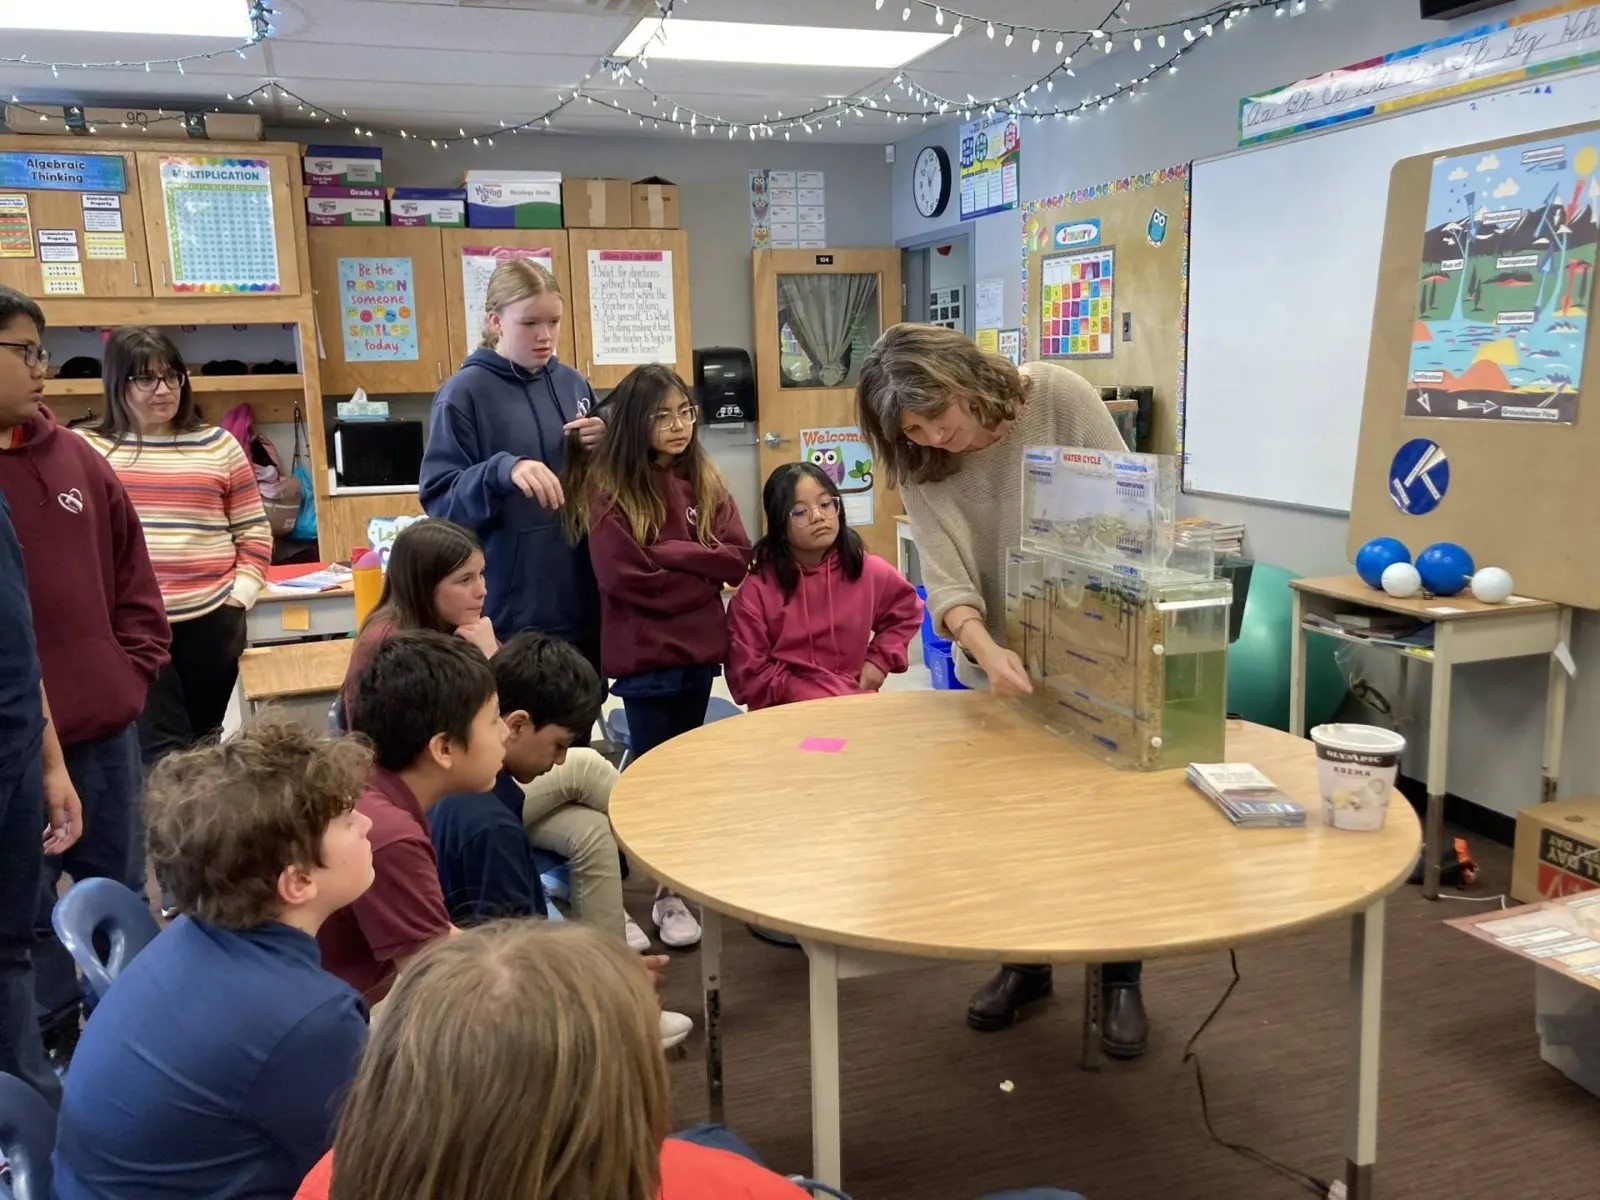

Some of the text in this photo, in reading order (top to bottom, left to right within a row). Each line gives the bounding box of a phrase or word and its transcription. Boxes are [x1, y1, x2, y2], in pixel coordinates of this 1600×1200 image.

[27, 159, 86, 170] Algebraic
[31, 171, 83, 183] Thinking
[172, 169, 260, 181] MULTIPLICATION
[475, 185, 503, 198] Moving
[1062, 228, 1092, 243] January
[1498, 257, 1538, 266] Transpiration
[358, 262, 394, 277] Be the
[346, 279, 407, 292] REASON
[351, 295, 405, 305] someone
[1498, 313, 1533, 321] Evaporation
[348, 324, 410, 337] SMILES
[364, 339, 398, 355] today
[1502, 407, 1541, 417] Groundwater
[802, 431, 870, 448] Welcome
[1063, 453, 1102, 465] WATER CYCLE
[1113, 463, 1147, 473] CONDENSATION
[1326, 750, 1382, 763] OLYMPIC
[1333, 766, 1371, 777] KREMA
